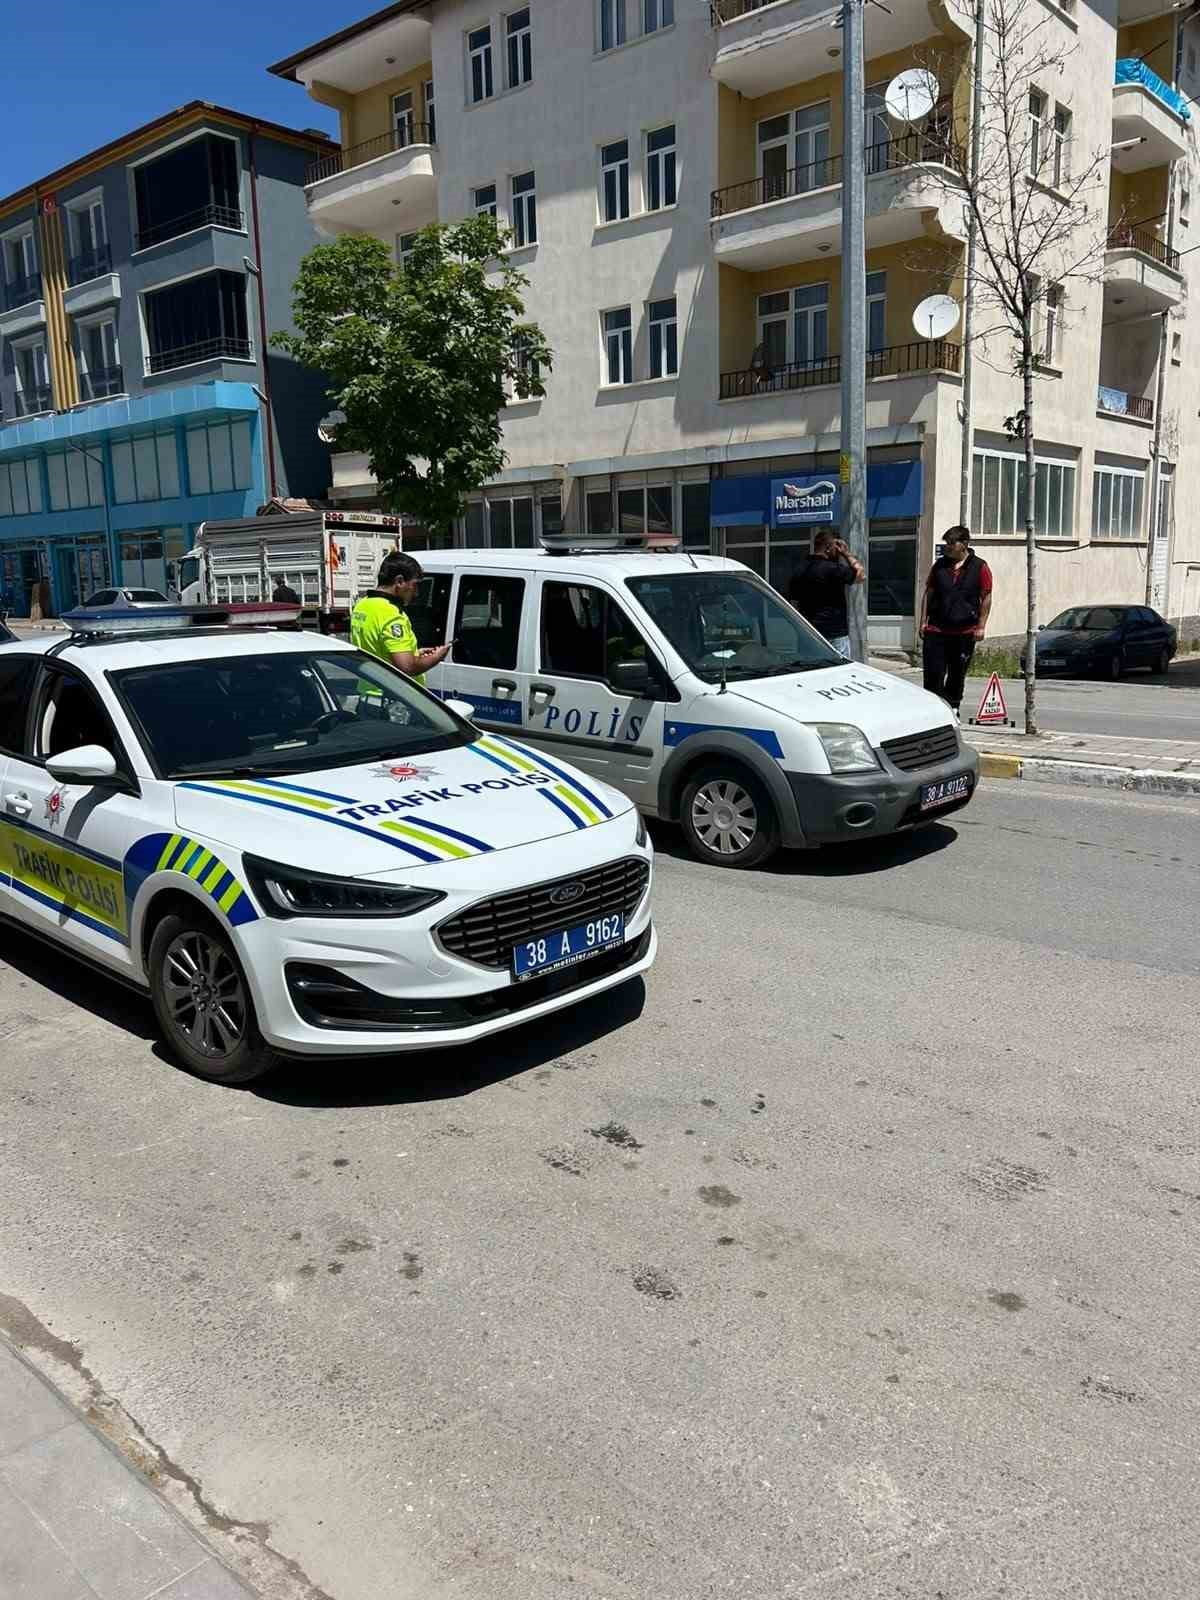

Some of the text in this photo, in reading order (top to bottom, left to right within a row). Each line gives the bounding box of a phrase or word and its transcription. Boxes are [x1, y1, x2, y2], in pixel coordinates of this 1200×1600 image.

[776, 493, 830, 510] Marshall
[544, 706, 644, 742] POLİS
[336, 768, 559, 822] TRAFİK POLİSİ
[13, 842, 120, 919] TRAFİK POLİSİ
[526, 914, 620, 967] 38 A 9162
